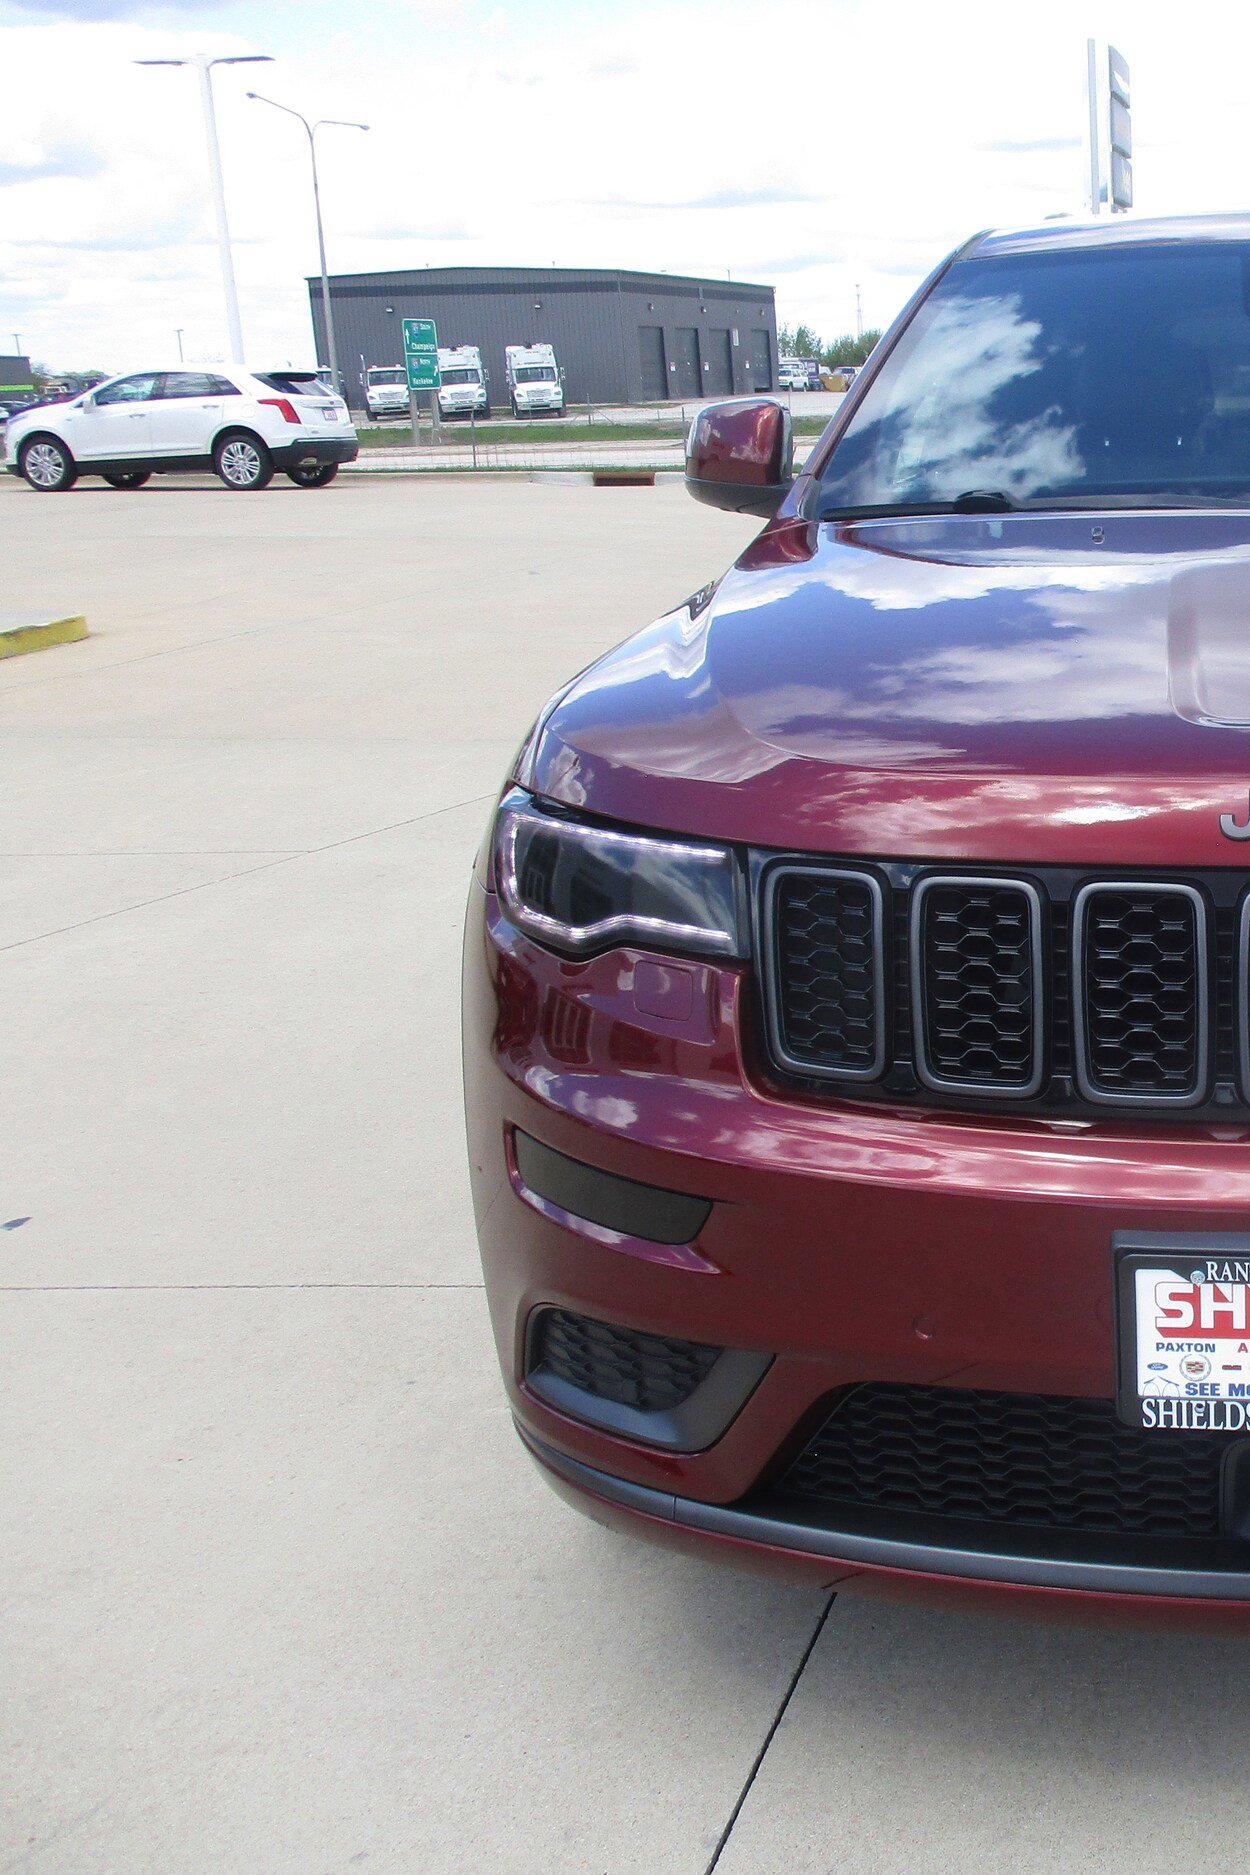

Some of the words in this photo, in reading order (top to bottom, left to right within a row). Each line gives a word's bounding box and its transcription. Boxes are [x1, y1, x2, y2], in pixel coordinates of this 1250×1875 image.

[411, 343, 435, 351] Champaign
[1156, 1342, 1215, 1353] PAXTON
[1186, 1383, 1221, 1396] SEE
